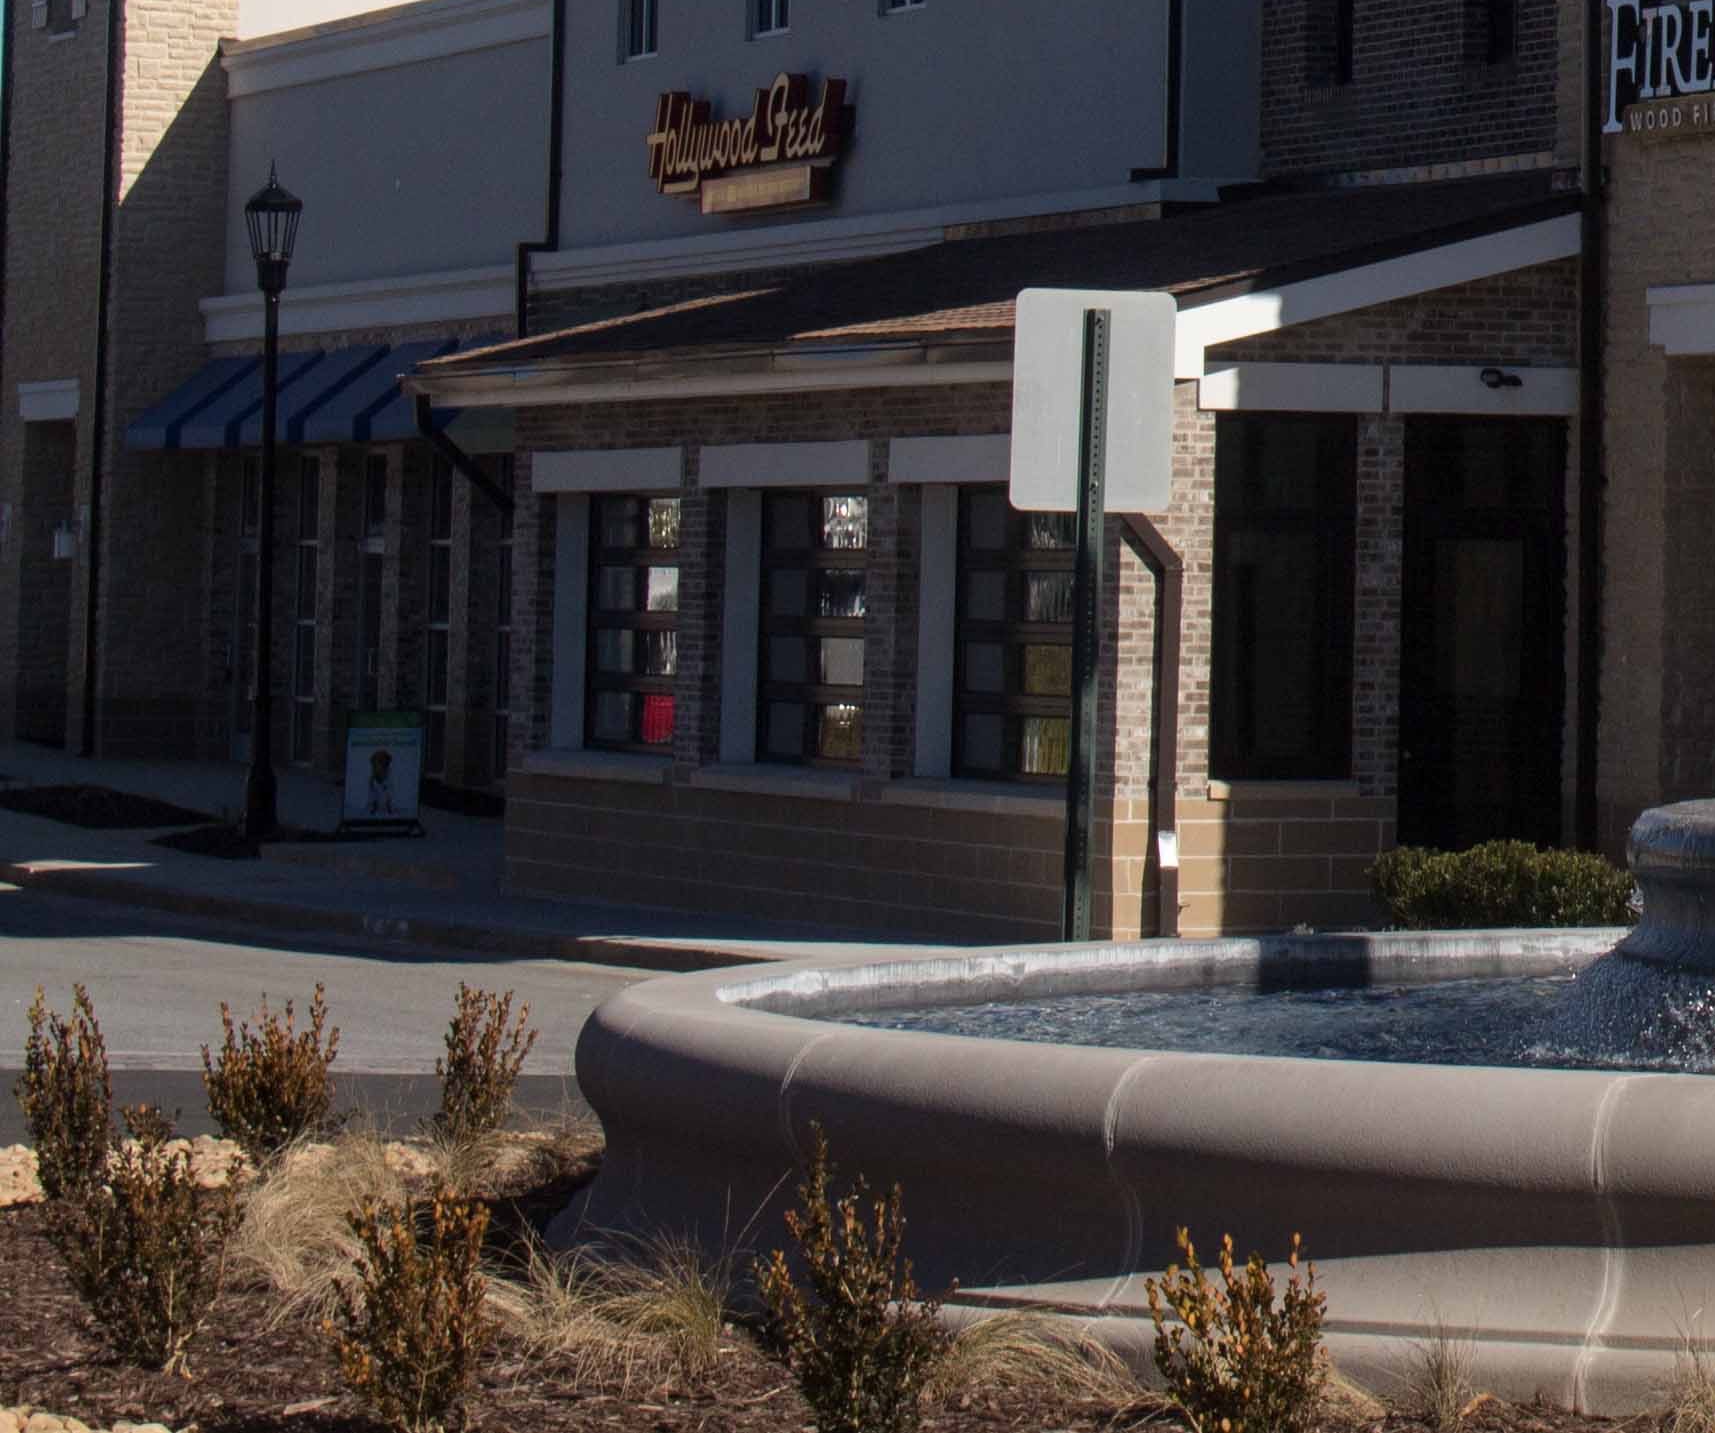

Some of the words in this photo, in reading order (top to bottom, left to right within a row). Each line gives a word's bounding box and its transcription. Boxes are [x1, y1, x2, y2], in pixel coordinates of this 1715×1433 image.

[646, 87, 760, 194] Hollywood
[760, 71, 826, 161] Feed
[1630, 107, 1682, 131] WOOD
